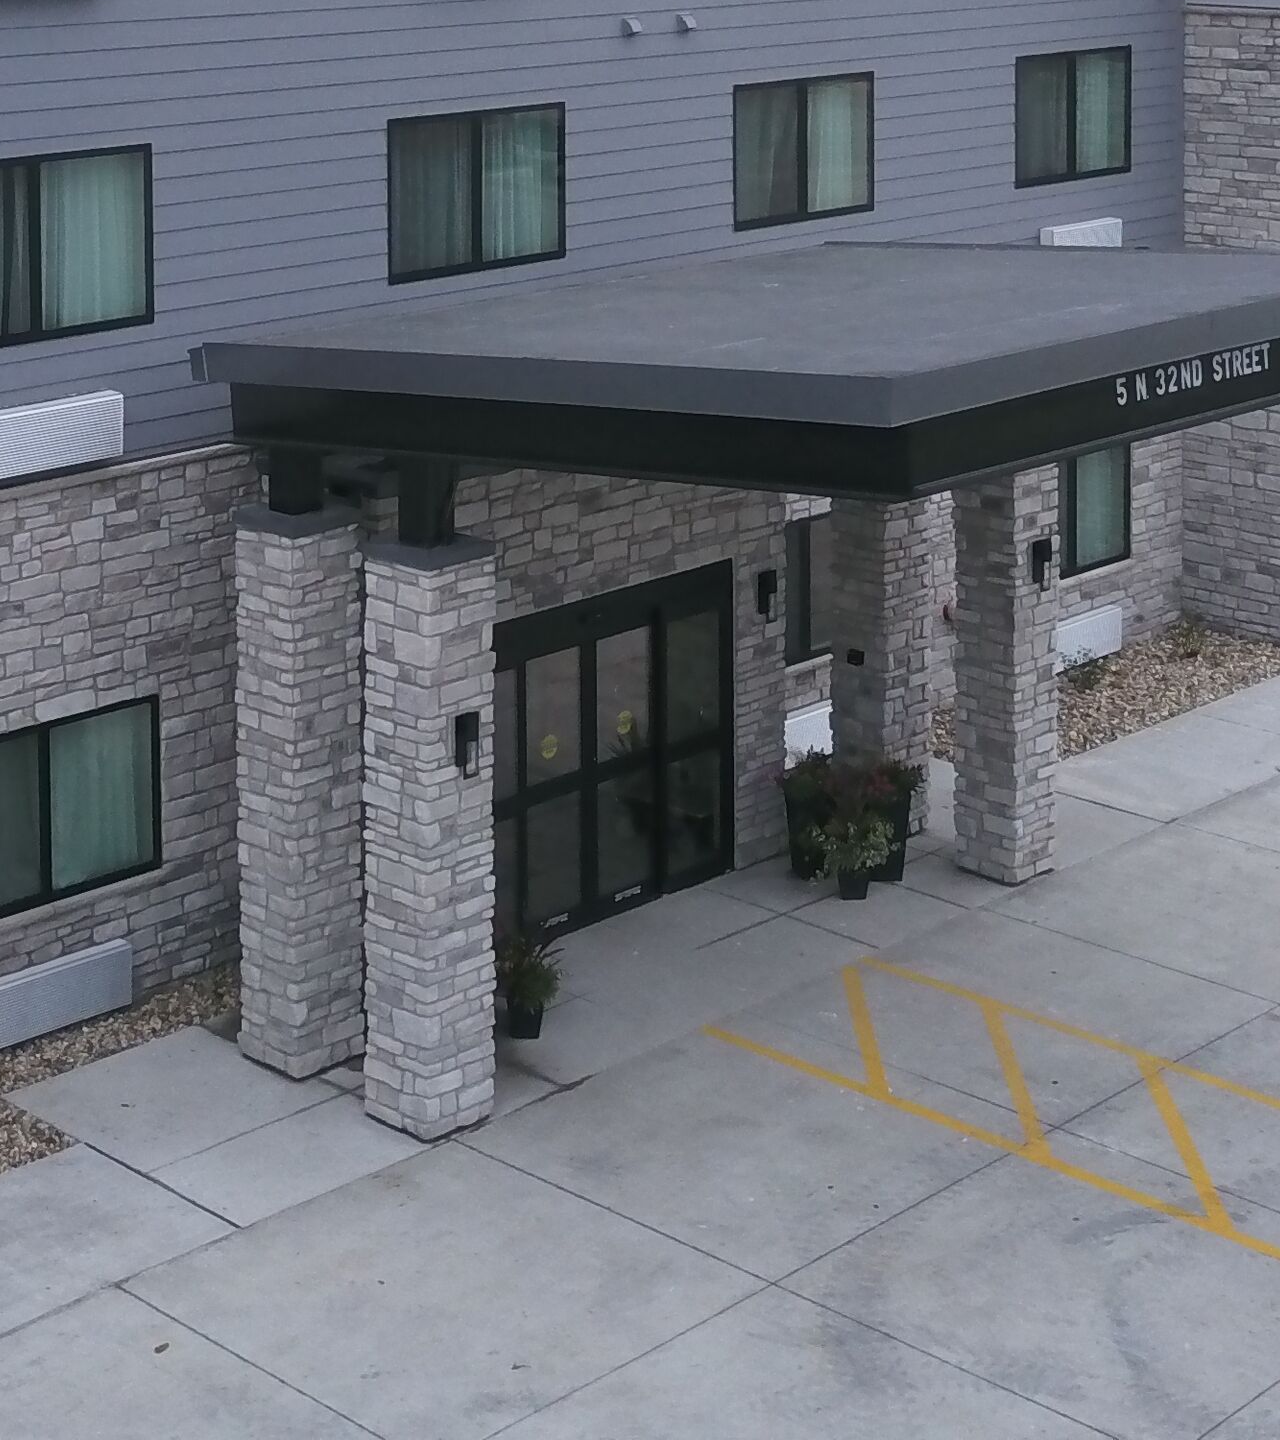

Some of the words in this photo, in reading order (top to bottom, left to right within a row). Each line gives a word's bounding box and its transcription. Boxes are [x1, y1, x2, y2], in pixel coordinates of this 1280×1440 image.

[1115, 377, 1127, 406] 5
[1155, 359, 1203, 396] 32ND
[1212, 342, 1270, 382] STREET
